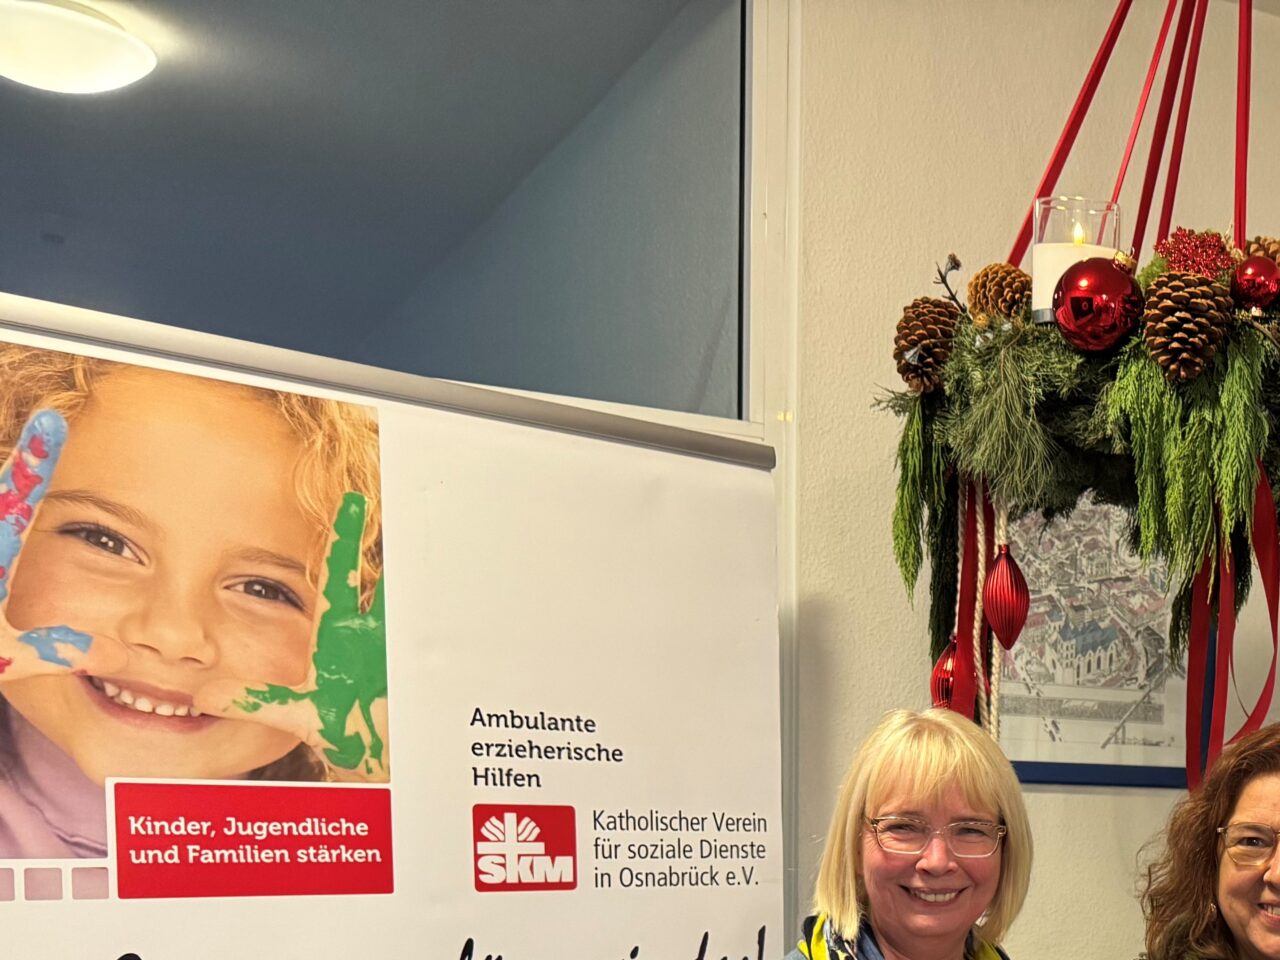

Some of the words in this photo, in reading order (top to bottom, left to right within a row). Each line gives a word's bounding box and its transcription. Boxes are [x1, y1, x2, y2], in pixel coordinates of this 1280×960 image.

[470, 707, 596, 733] Ambulante
[471, 739, 623, 762] erzieherische
[472, 767, 541, 787] Hilfen
[129, 816, 216, 838] Kinder,
[223, 817, 368, 839] Jugendliche
[593, 809, 707, 832] Katholischer
[712, 812, 767, 832] Verein
[130, 845, 180, 863] und
[187, 845, 290, 863] Familien
[297, 845, 382, 863] stärken
[593, 837, 621, 859] für
[628, 838, 693, 859] soziale
[700, 839, 766, 859] Dienste
[477, 855, 574, 883] SKM
[595, 867, 611, 888] in
[620, 865, 719, 887] Osnabrück
[726, 866, 758, 886] e.V.
